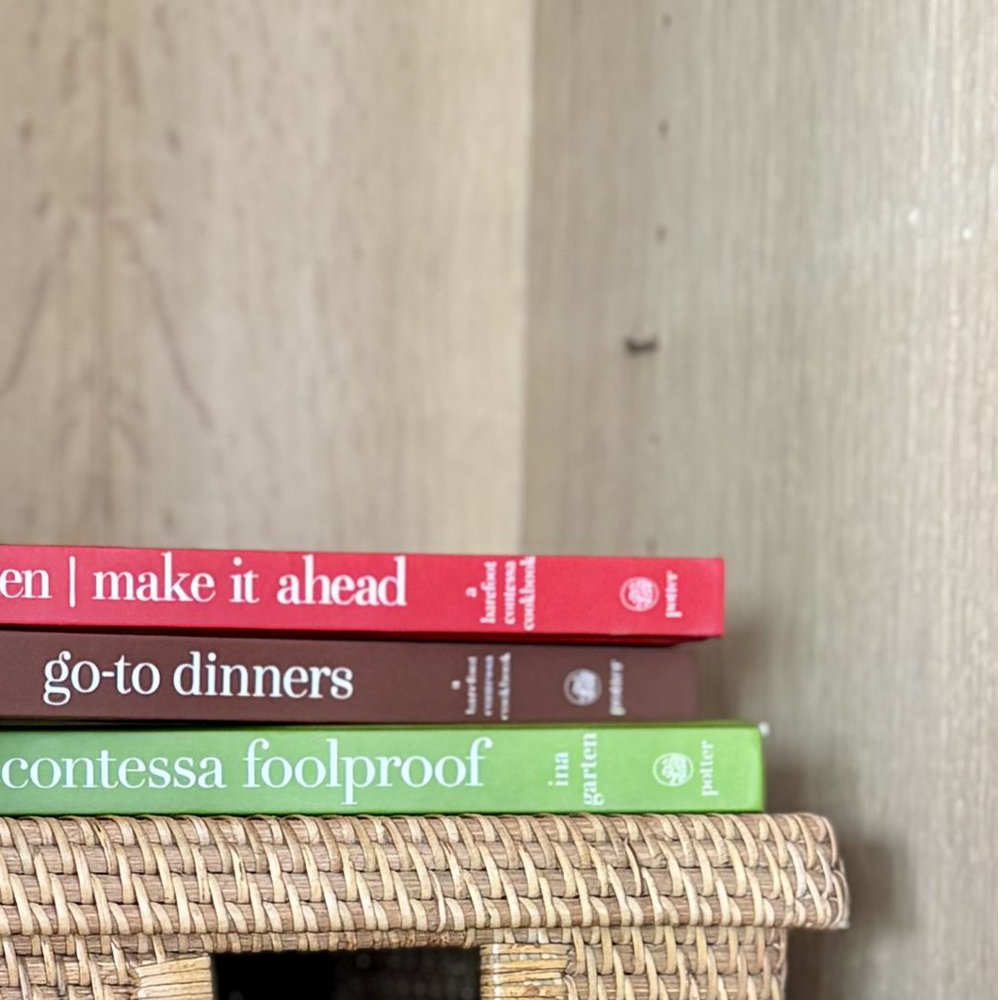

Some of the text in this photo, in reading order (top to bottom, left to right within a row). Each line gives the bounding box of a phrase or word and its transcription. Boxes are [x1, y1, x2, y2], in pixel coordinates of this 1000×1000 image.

[92, 551, 216, 602] make
[230, 556, 260, 604] it
[276, 553, 407, 607] ahead
[43, 650, 354, 706] go-to dinners
[1, 749, 228, 790] contessa
[242, 737, 493, 806] foolproof
[548, 751, 570, 787] ina
[580, 732, 605, 807] garten
